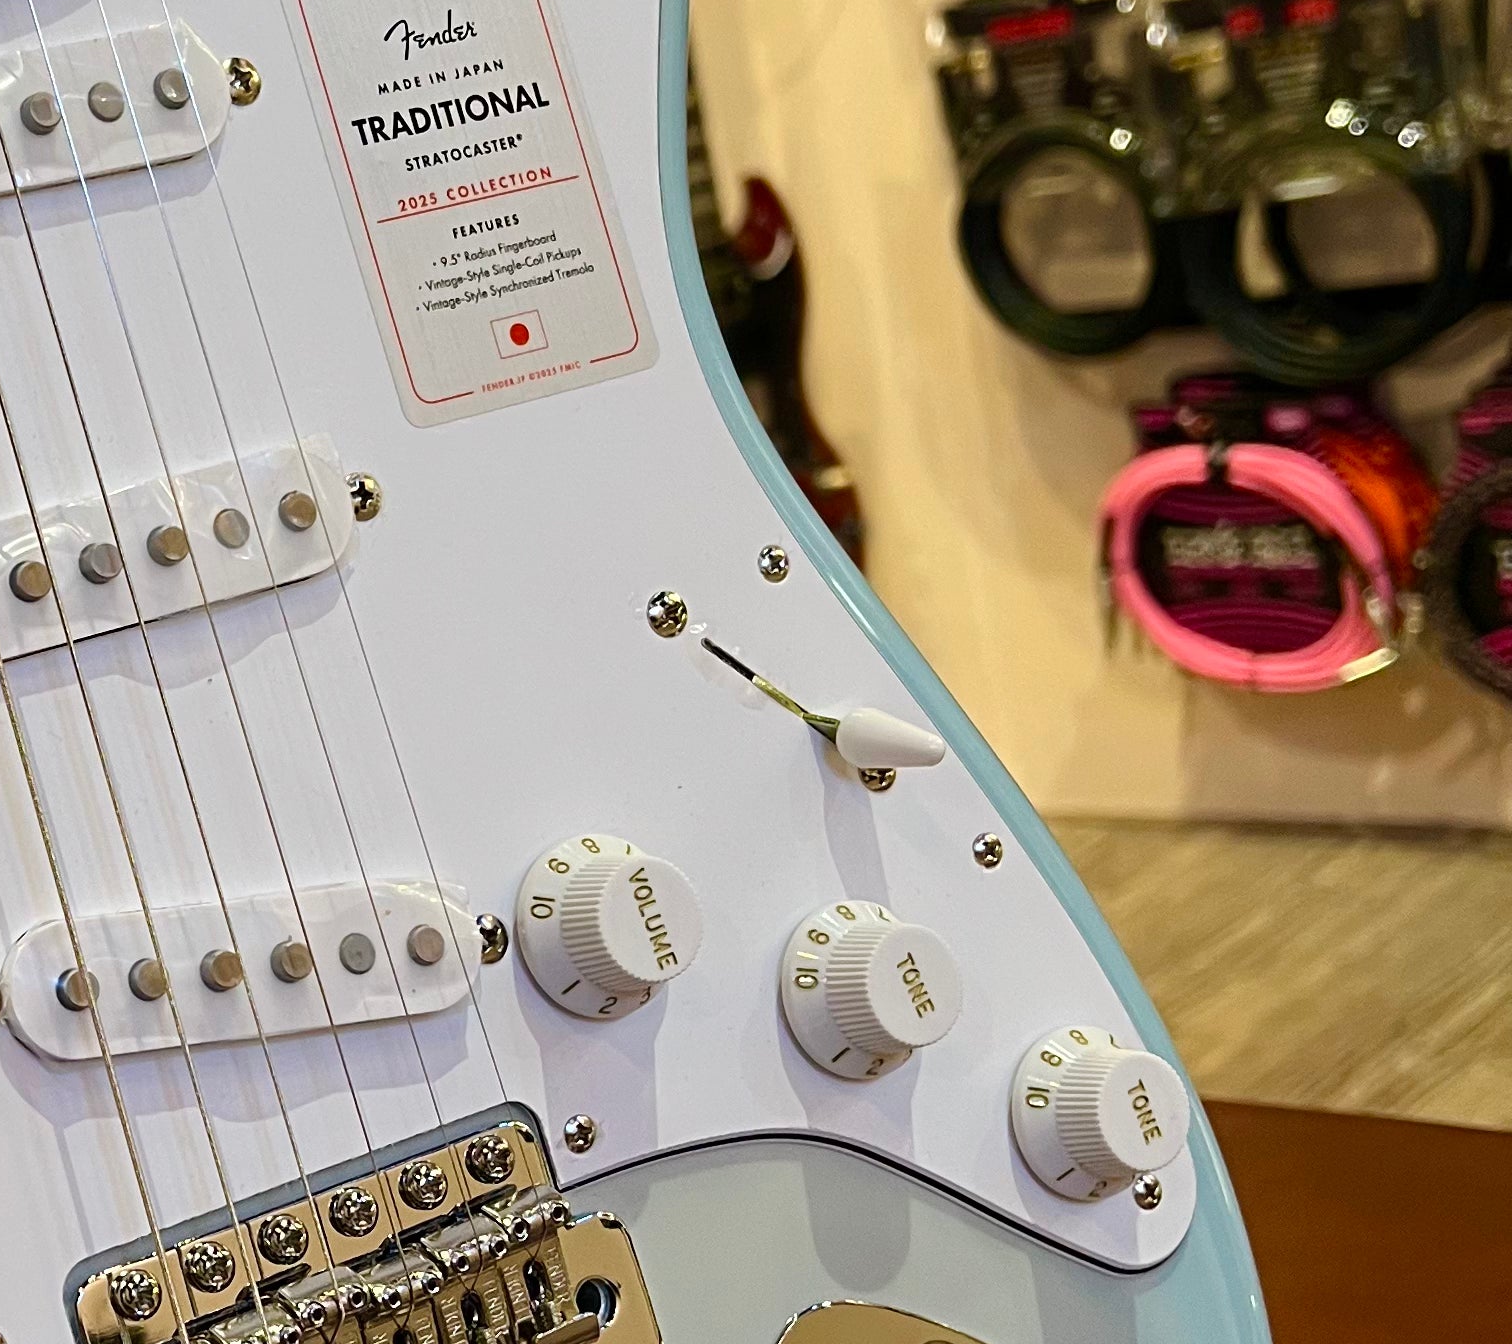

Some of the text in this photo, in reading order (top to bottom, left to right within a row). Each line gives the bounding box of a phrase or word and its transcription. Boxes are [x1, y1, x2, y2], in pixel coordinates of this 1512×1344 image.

[384, 9, 477, 60] Fender
[378, 58, 504, 95] MADE IN JAPAN
[351, 82, 550, 146] TRADITIONAL
[397, 166, 552, 212] 2025 COLLECTION
[452, 213, 520, 239] FEATURES
[464, 247, 497, 262] Radius
[497, 230, 557, 255] Fingerboard
[424, 247, 582, 291] Vintage-Style Single-Coil Pickups
[422, 262, 594, 312] Vintage-Style Synchronized Tremolo
[581, 837, 601, 854] 8
[547, 858, 570, 874] 9
[530, 895, 556, 920] 10
[628, 867, 678, 971] VOLUME
[835, 905, 857, 921] 8
[561, 979, 581, 996] 1
[794, 967, 819, 990] 10
[896, 951, 935, 1019] TONE
[598, 996, 618, 1015] 2
[1068, 1029, 1089, 1046] 8
[831, 1046, 851, 1063] 1
[865, 1058, 884, 1076] 2
[1025, 1086, 1050, 1109] 10
[1127, 1078, 1163, 1146] TONE
[1055, 1167, 1076, 1182] 1
[502, 1263, 531, 1321] ENDER
